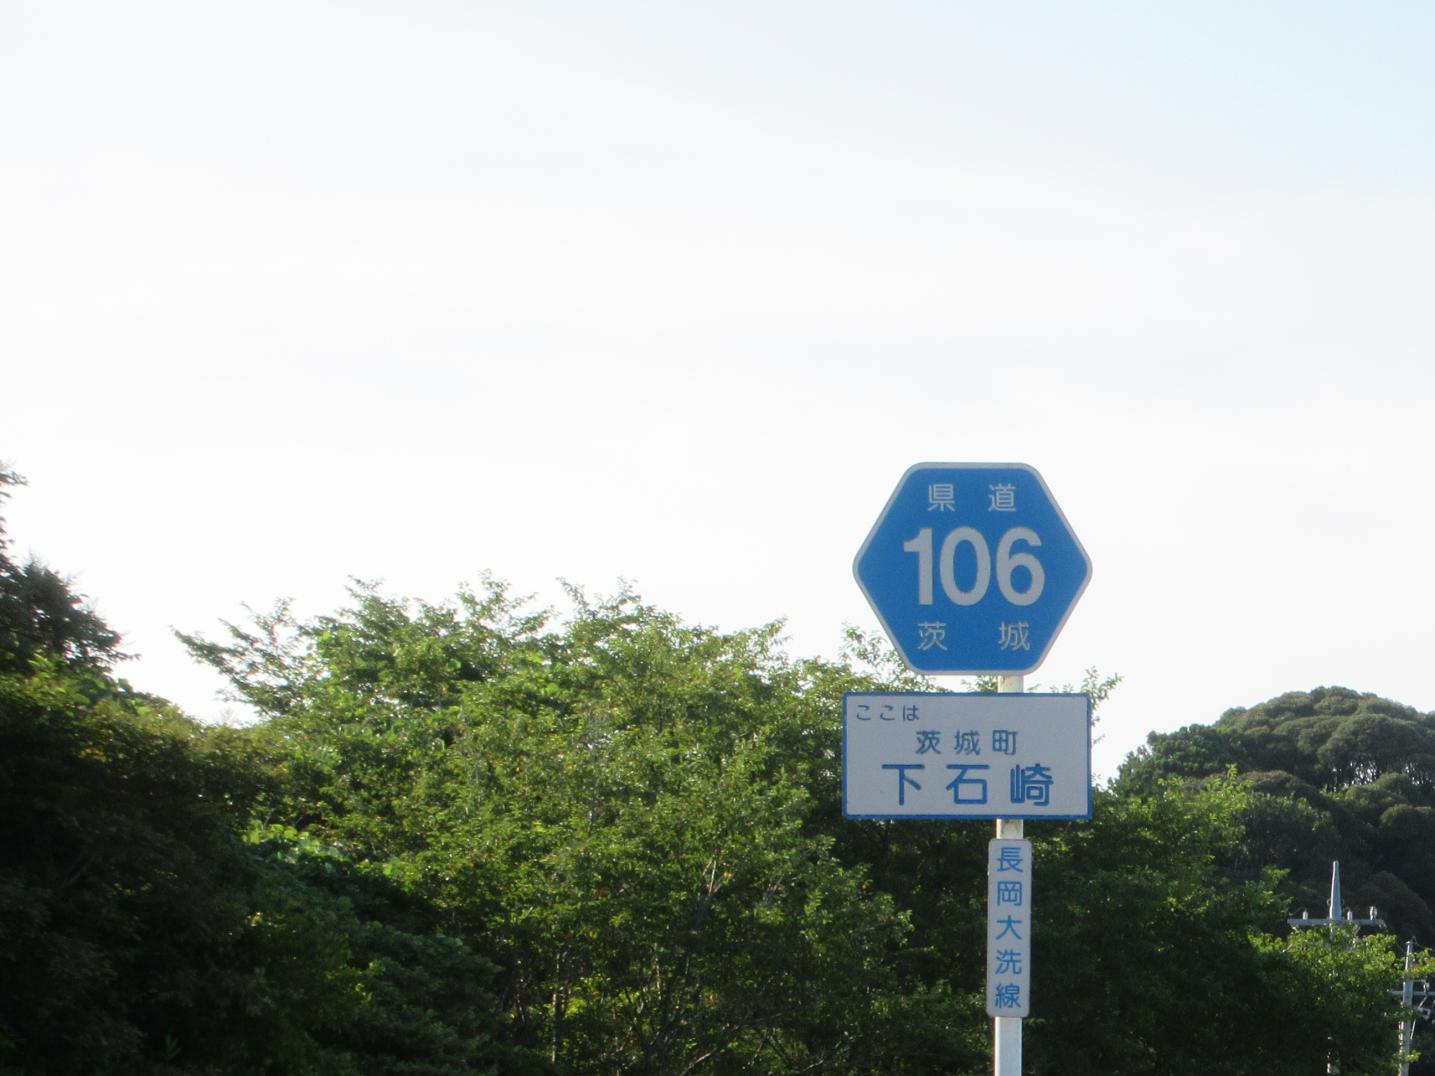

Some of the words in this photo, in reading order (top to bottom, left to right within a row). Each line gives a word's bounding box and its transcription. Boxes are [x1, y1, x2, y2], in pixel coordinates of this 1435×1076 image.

[928, 484, 1017, 512] 県道
[903, 526, 1046, 606] 106
[917, 621, 1031, 651] 茨城
[856, 704, 920, 722] ここは
[915, 729, 1019, 756] 茨城町
[881, 763, 1054, 807] 下石崎
[995, 847, 1024, 1009] 長岡大洗線
